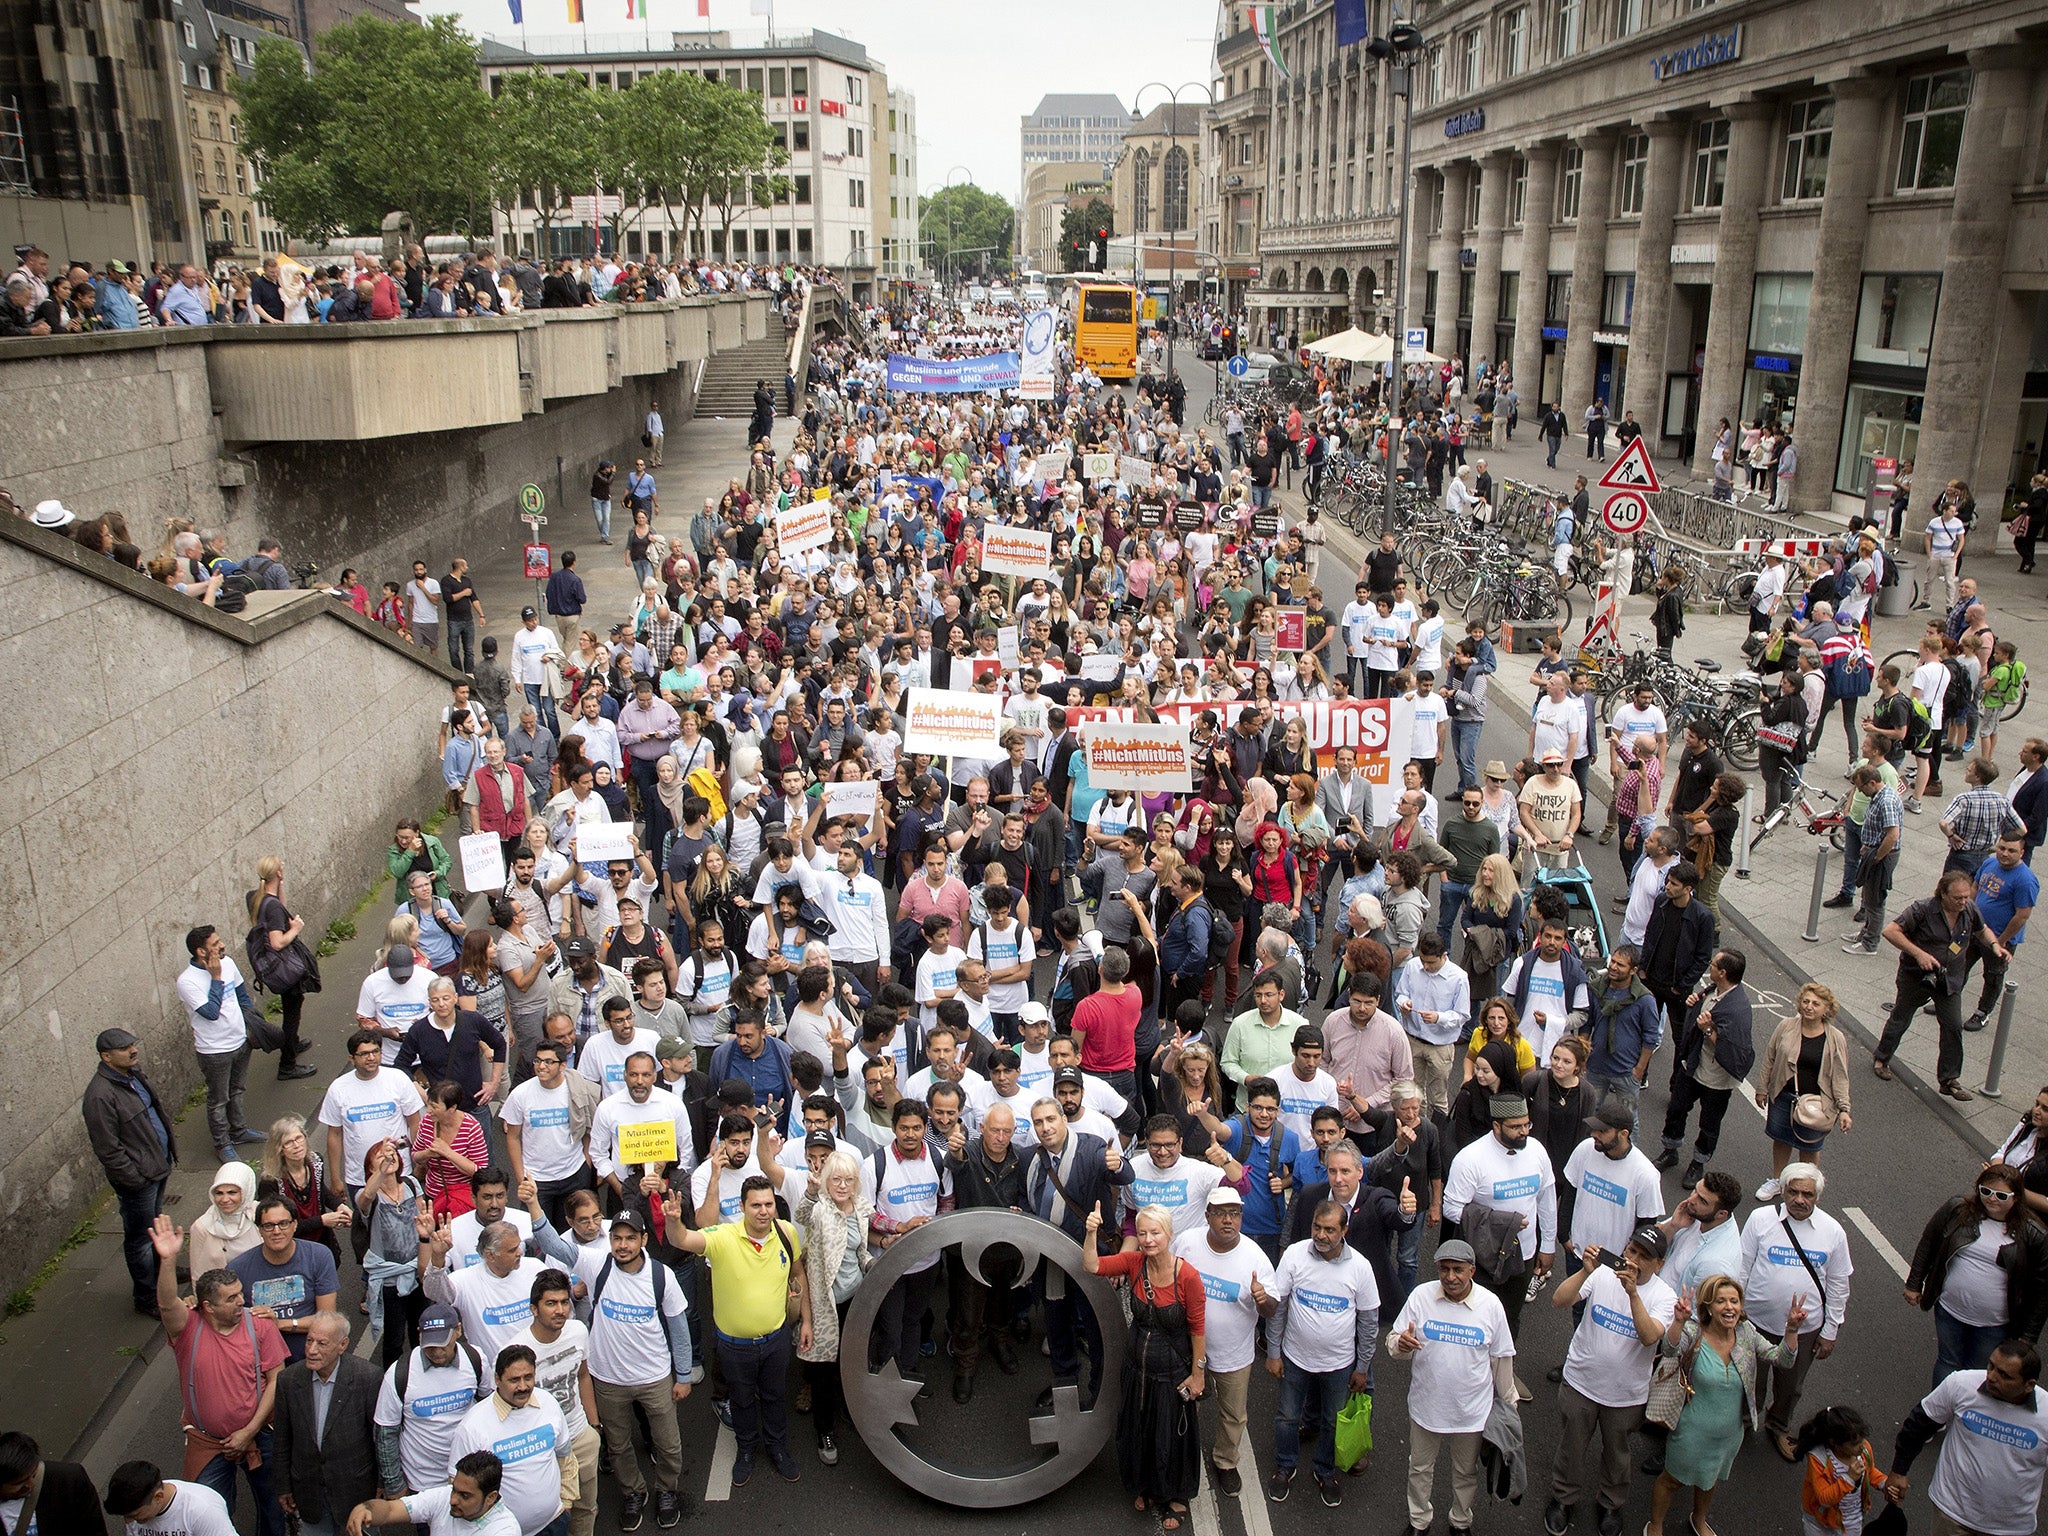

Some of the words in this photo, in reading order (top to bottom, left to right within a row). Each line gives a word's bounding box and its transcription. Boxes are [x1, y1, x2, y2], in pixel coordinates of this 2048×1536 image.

[1672, 22, 1739, 75] randstad
[905, 363, 943, 375] Muslime
[944, 365, 961, 375] und
[892, 372, 922, 383] GEGEN
[923, 376, 959, 385] TERROR
[961, 374, 981, 383] UND
[983, 370, 1017, 382] GEWALT
[979, 381, 996, 390] Nicht
[1611, 504, 1638, 522] 40
[987, 543, 1047, 559] #NichtMitUns
[913, 713, 994, 730] #NichtMitUns
[1093, 749, 1184, 763] #NichtMitUns
[1536, 793, 1567, 808] NASTY
[1531, 985, 1557, 995] FRIEDEN
[348, 1105, 379, 1115] Muslime
[379, 1103, 390, 1111] für
[1282, 1099, 1310, 1107] Muslime
[360, 1109, 395, 1121] FRIEDEN
[1293, 1106, 1313, 1116] FRIED
[539, 1117, 569, 1126] FRIEDEN
[626, 1128, 667, 1138] Muslime
[625, 1141, 641, 1149] sind
[642, 1139, 653, 1148] für
[633, 1149, 662, 1158] Frieden
[890, 1187, 921, 1198] Muslime
[921, 1184, 932, 1192] für
[1153, 1183, 1165, 1194] für
[1495, 1181, 1519, 1192] Muslime
[1519, 1179, 1528, 1187] für
[1504, 1186, 1535, 1198] FRIEDEN
[903, 1191, 934, 1203] FRIEDEN
[1587, 1184, 1618, 1202] FRIEDEN
[1784, 1257, 1823, 1268] FRIEEN
[1213, 1280, 1222, 1289] für
[1205, 1287, 1228, 1298] IEDEN
[1297, 1288, 1330, 1305] Muslime
[1331, 1296, 1342, 1305] für
[486, 1304, 518, 1316] Muslime
[603, 1299, 637, 1315] Muslime
[637, 1307, 649, 1315] für
[1308, 1301, 1345, 1312] FRIEDEN
[499, 1309, 533, 1324] FRIEDE
[612, 1311, 652, 1323] FRIEDEN
[1593, 1305, 1628, 1324] Muslime
[1426, 1320, 1464, 1335] Muslime
[1464, 1328, 1477, 1336] für
[1603, 1320, 1637, 1338] FRIEDE
[1439, 1333, 1481, 1346] FRIEDEN
[415, 1395, 455, 1408] Muslime
[456, 1391, 467, 1400] für
[431, 1400, 472, 1415] FRIEDEN
[1966, 1411, 2011, 1434] Muslime
[2012, 1428, 2027, 1438] für
[496, 1437, 526, 1453] Muslime
[527, 1432, 538, 1443] für
[1980, 1427, 2032, 1450] FRIEDEN
[508, 1440, 547, 1460] FRIEDEN
[138, 1527, 169, 1536] MUSLIME
